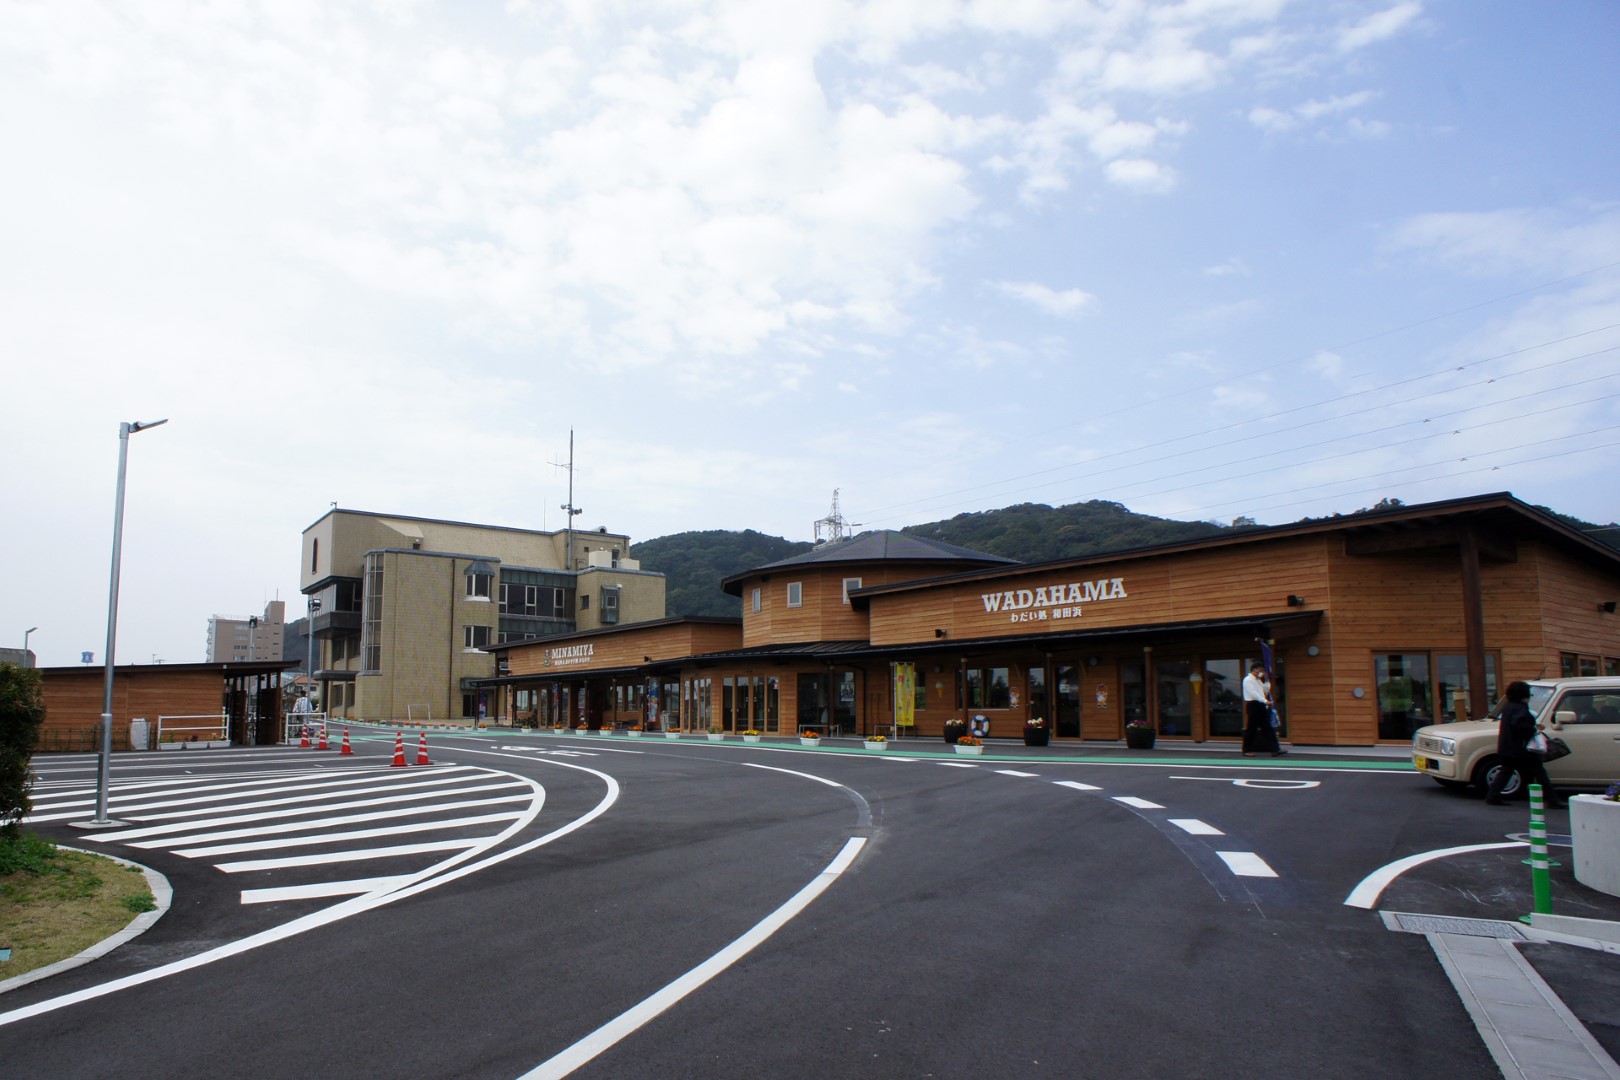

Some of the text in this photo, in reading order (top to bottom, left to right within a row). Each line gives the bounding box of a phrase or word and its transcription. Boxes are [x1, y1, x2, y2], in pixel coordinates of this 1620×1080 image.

[981, 577, 1128, 613] WADAHAMA
[1010, 606, 1082, 622] わだい処 和田浜
[552, 643, 594, 659] MINAMIYA
